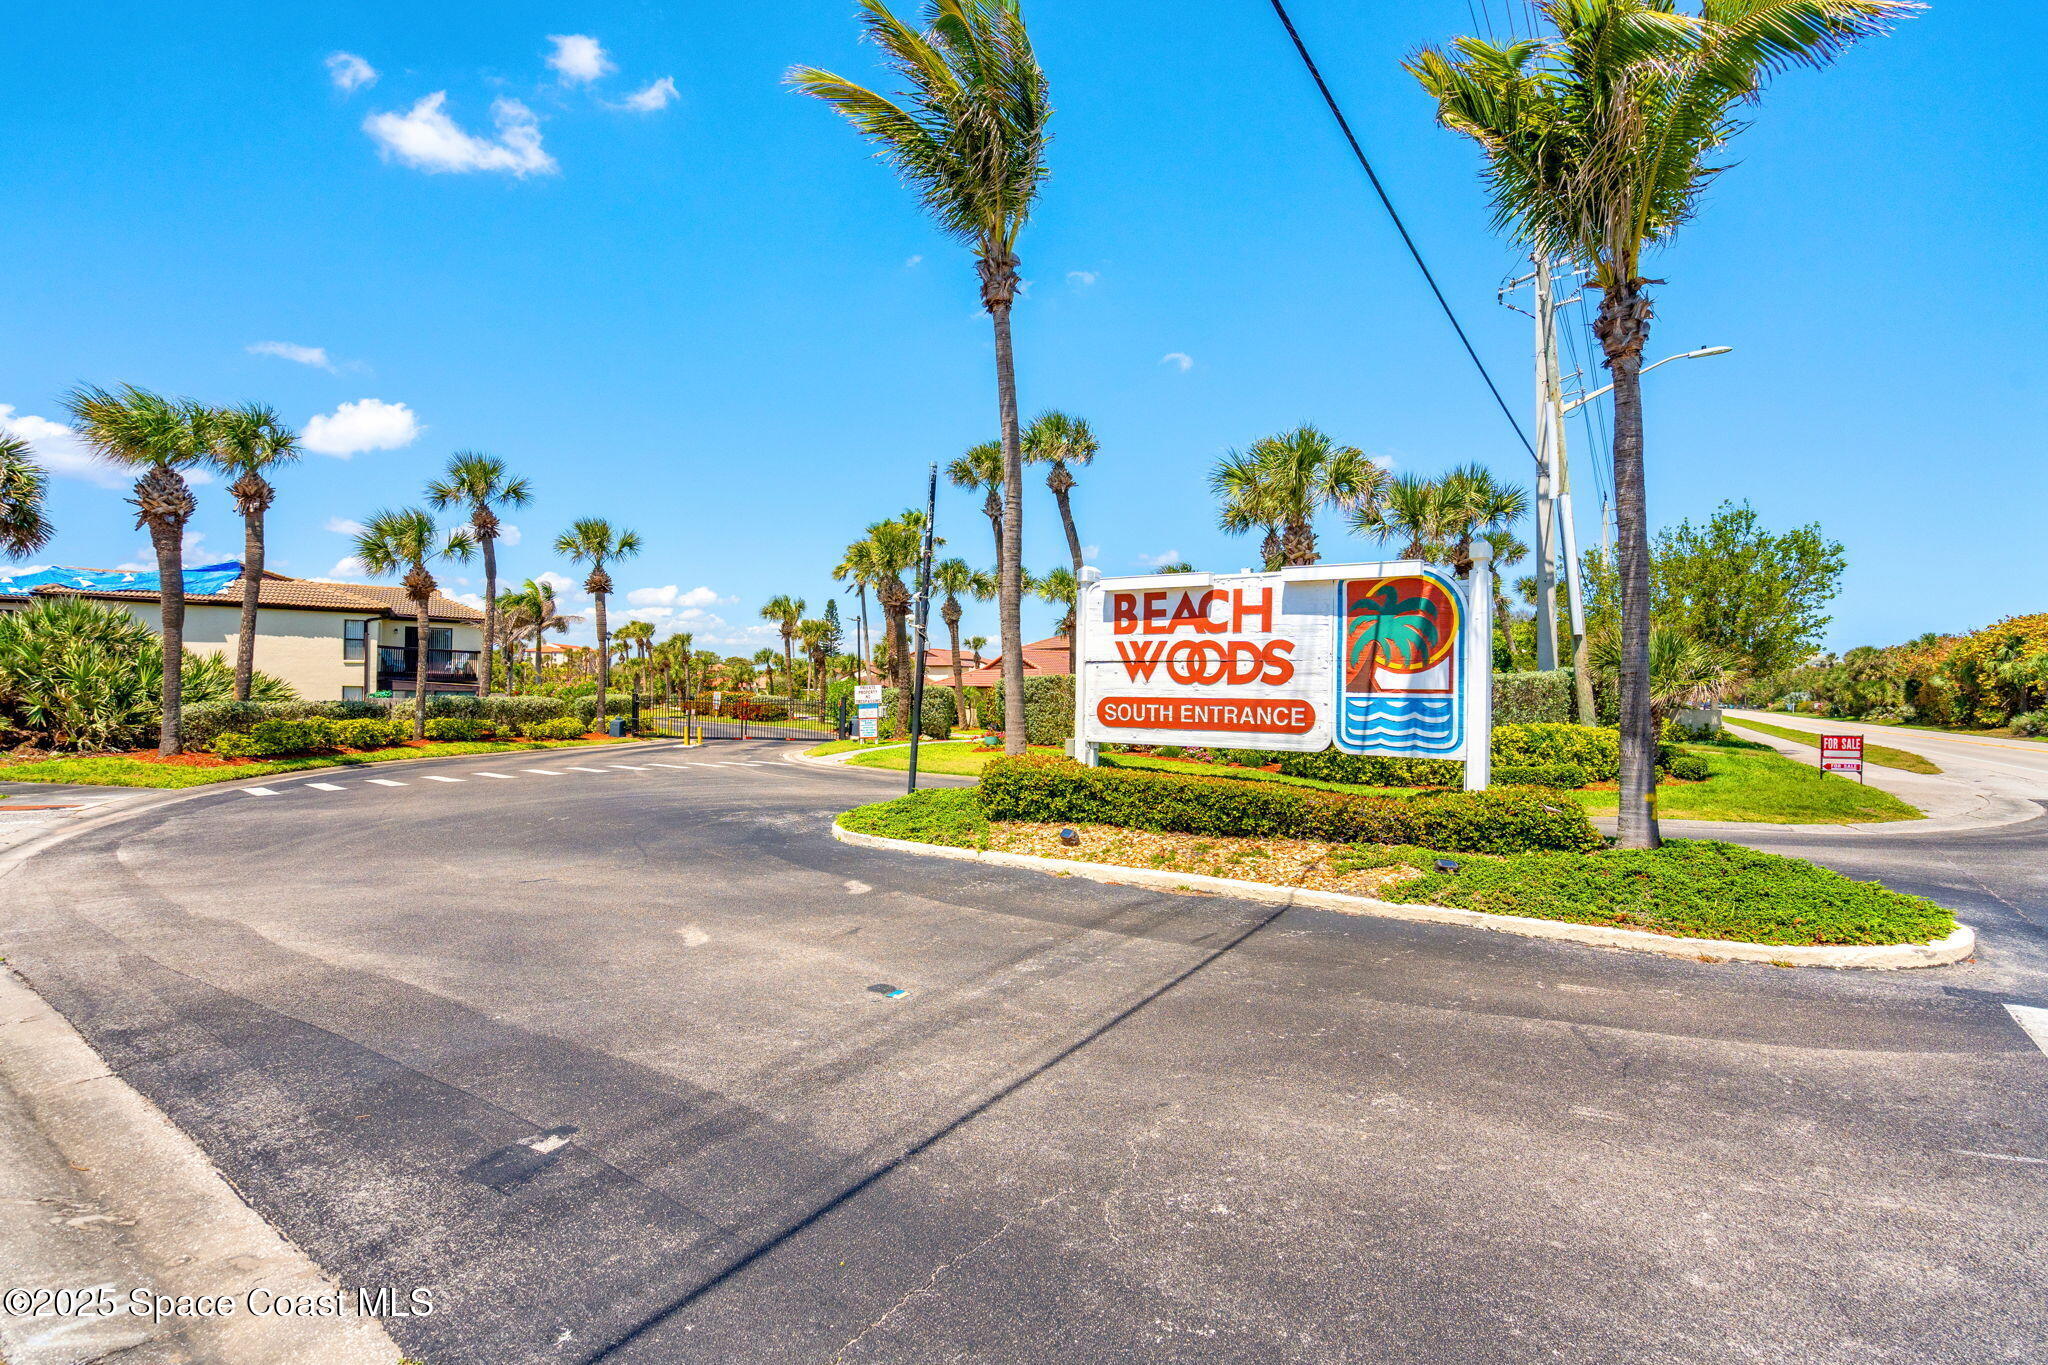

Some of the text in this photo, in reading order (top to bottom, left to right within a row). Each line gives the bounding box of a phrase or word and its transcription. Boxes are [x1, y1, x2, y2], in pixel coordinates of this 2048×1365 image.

[1113, 587, 1273, 635] BEACH
[1116, 639, 1296, 686] WOODS
[1104, 703, 1306, 726] SOUTH ENTRANCE
[1823, 738, 1861, 750] FOR SALE
